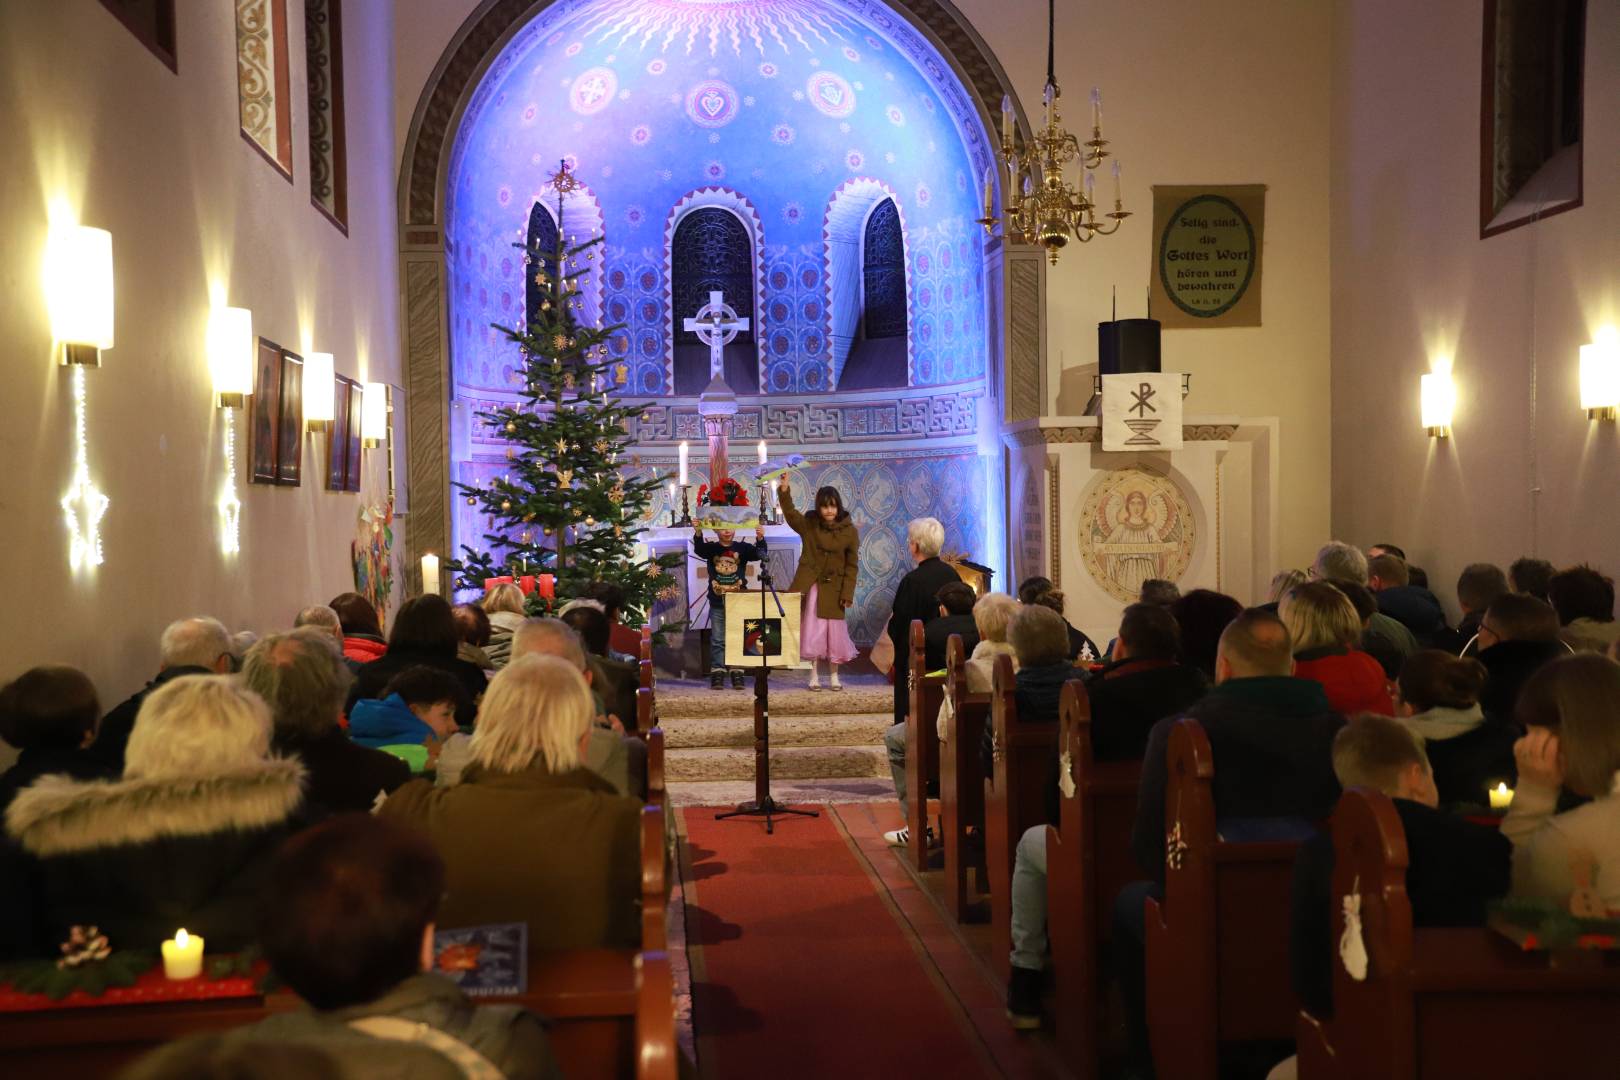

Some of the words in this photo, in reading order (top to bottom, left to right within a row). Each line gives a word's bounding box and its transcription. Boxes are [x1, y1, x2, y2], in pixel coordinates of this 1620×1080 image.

[1180, 217, 1208, 229] Selig
[1199, 235, 1217, 244] die
[1167, 249, 1209, 261] Gottes
[1216, 249, 1249, 260] Wort
[1176, 269, 1209, 278] hören
[1215, 269, 1237, 277] und
[1177, 281, 1235, 291] bewahren
